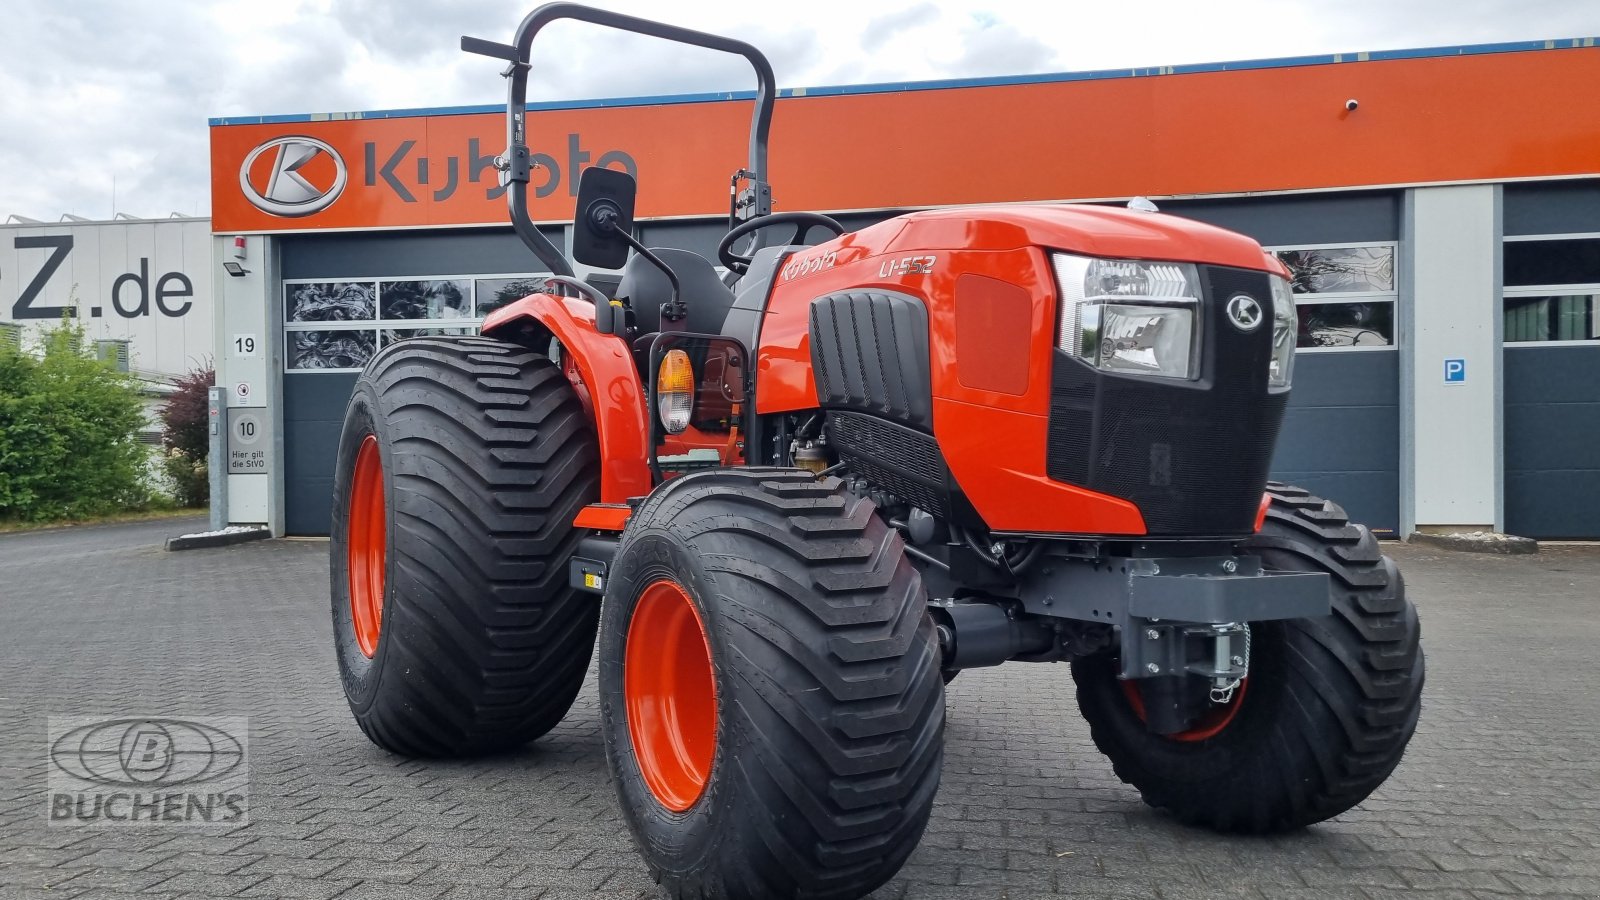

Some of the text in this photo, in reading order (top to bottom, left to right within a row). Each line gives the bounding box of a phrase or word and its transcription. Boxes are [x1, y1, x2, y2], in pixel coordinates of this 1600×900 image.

[781, 249, 838, 281] Kubota
[879, 255, 937, 278] L1-552
[0, 234, 193, 319] Z.de
[235, 337, 255, 353] 19
[1447, 361, 1462, 380] P
[240, 422, 255, 436] 10
[251, 450, 264, 460] gilt
[232, 460, 265, 468] die StVO
